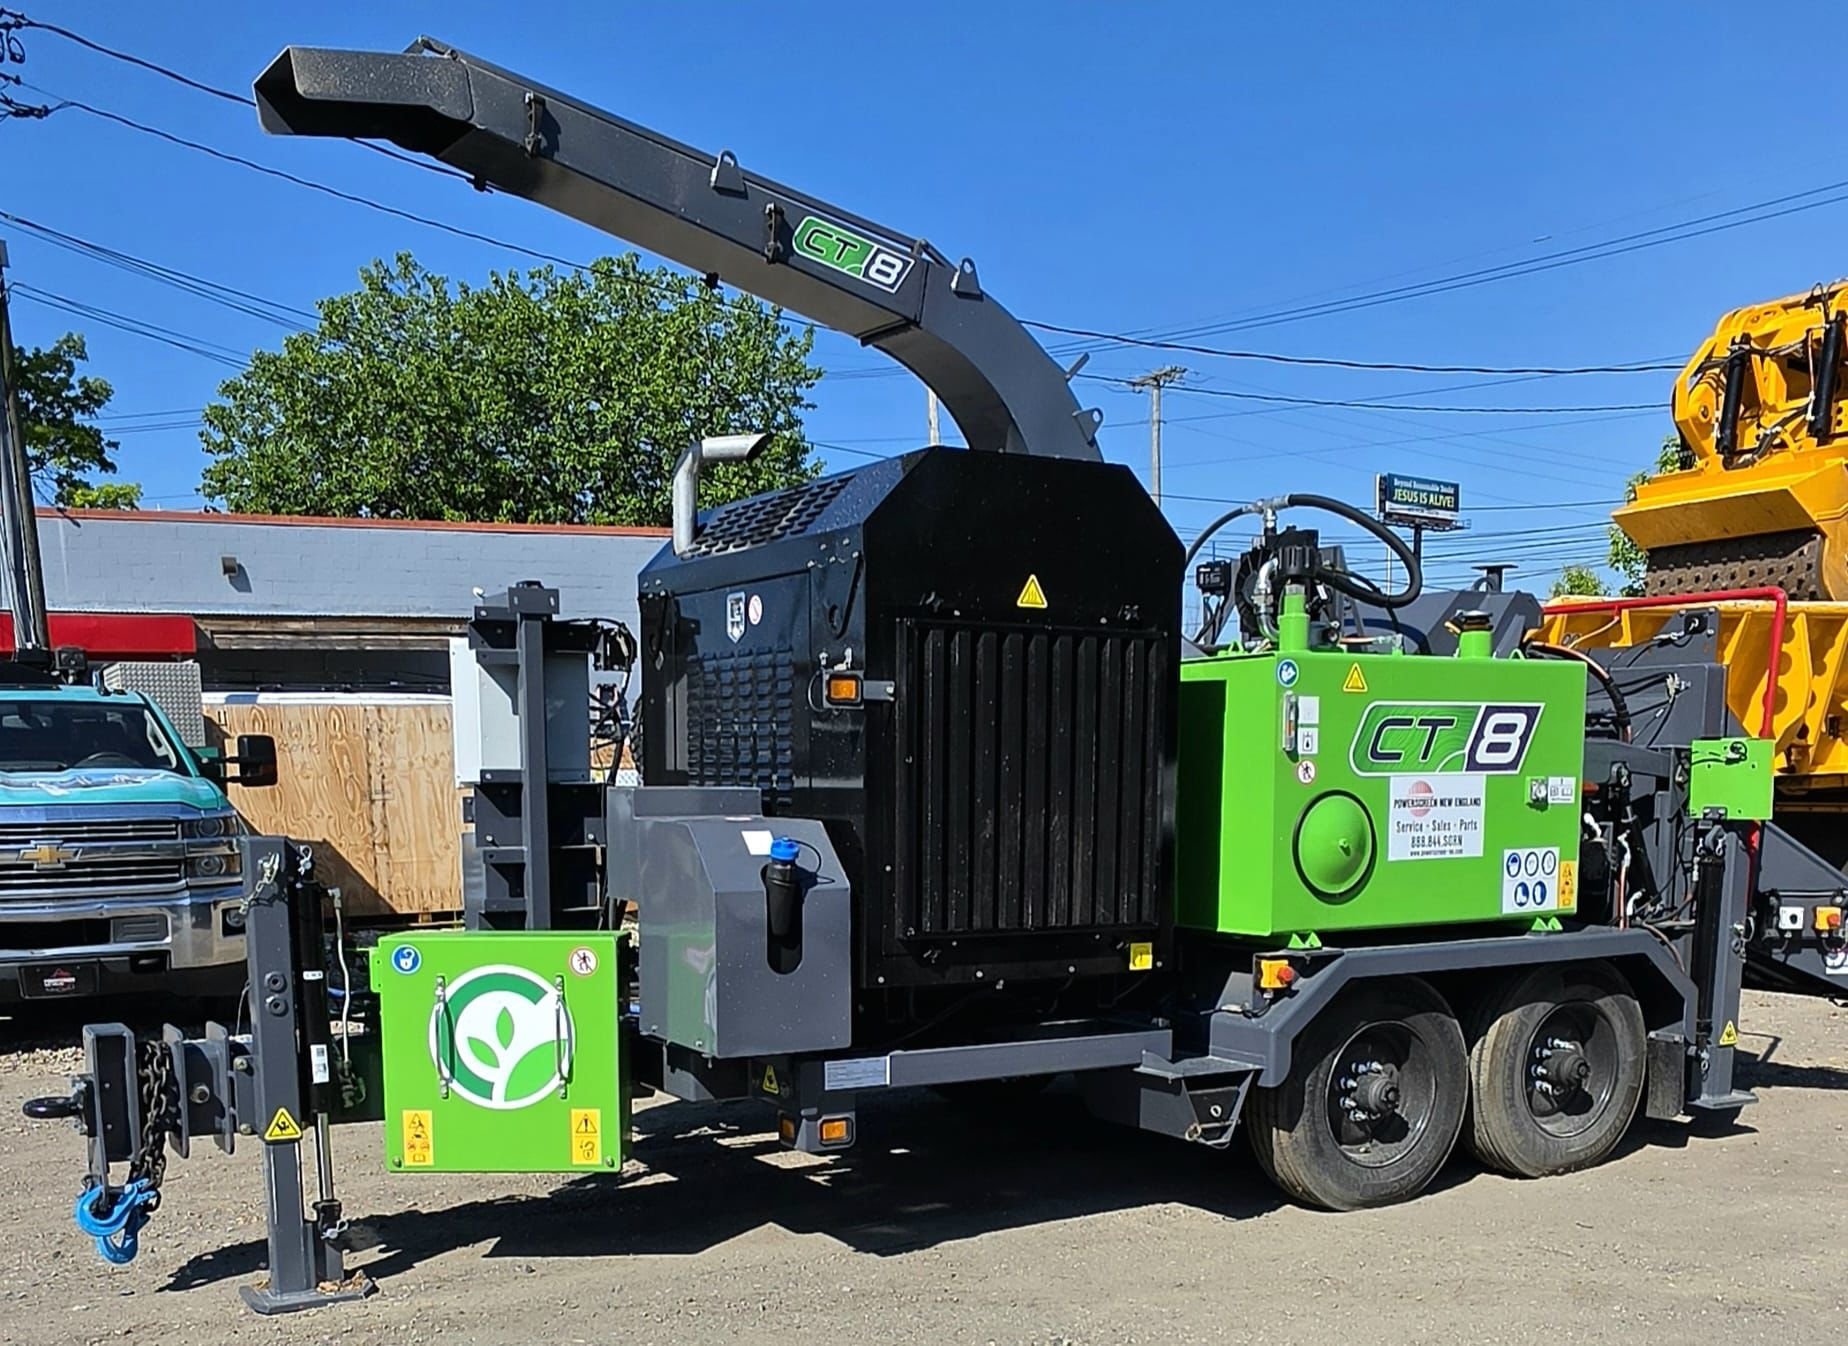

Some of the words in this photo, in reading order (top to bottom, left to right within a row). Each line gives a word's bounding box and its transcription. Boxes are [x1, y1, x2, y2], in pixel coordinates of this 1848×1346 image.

[804, 227, 860, 262] CT
[869, 253, 903, 284] 8
[1393, 488, 1419, 503] JESUS
[1420, 492, 1428, 504] IS
[1368, 716, 1457, 762] CT
[1476, 713, 1527, 763] 8
[1394, 798, 1437, 808] POWERSCREEN
[1440, 798, 1453, 807] NEW
[1454, 797, 1481, 807] ENGLAND
[1396, 820, 1423, 833] Service
[1432, 819, 1451, 832] Sales
[1460, 818, 1477, 831] Parts
